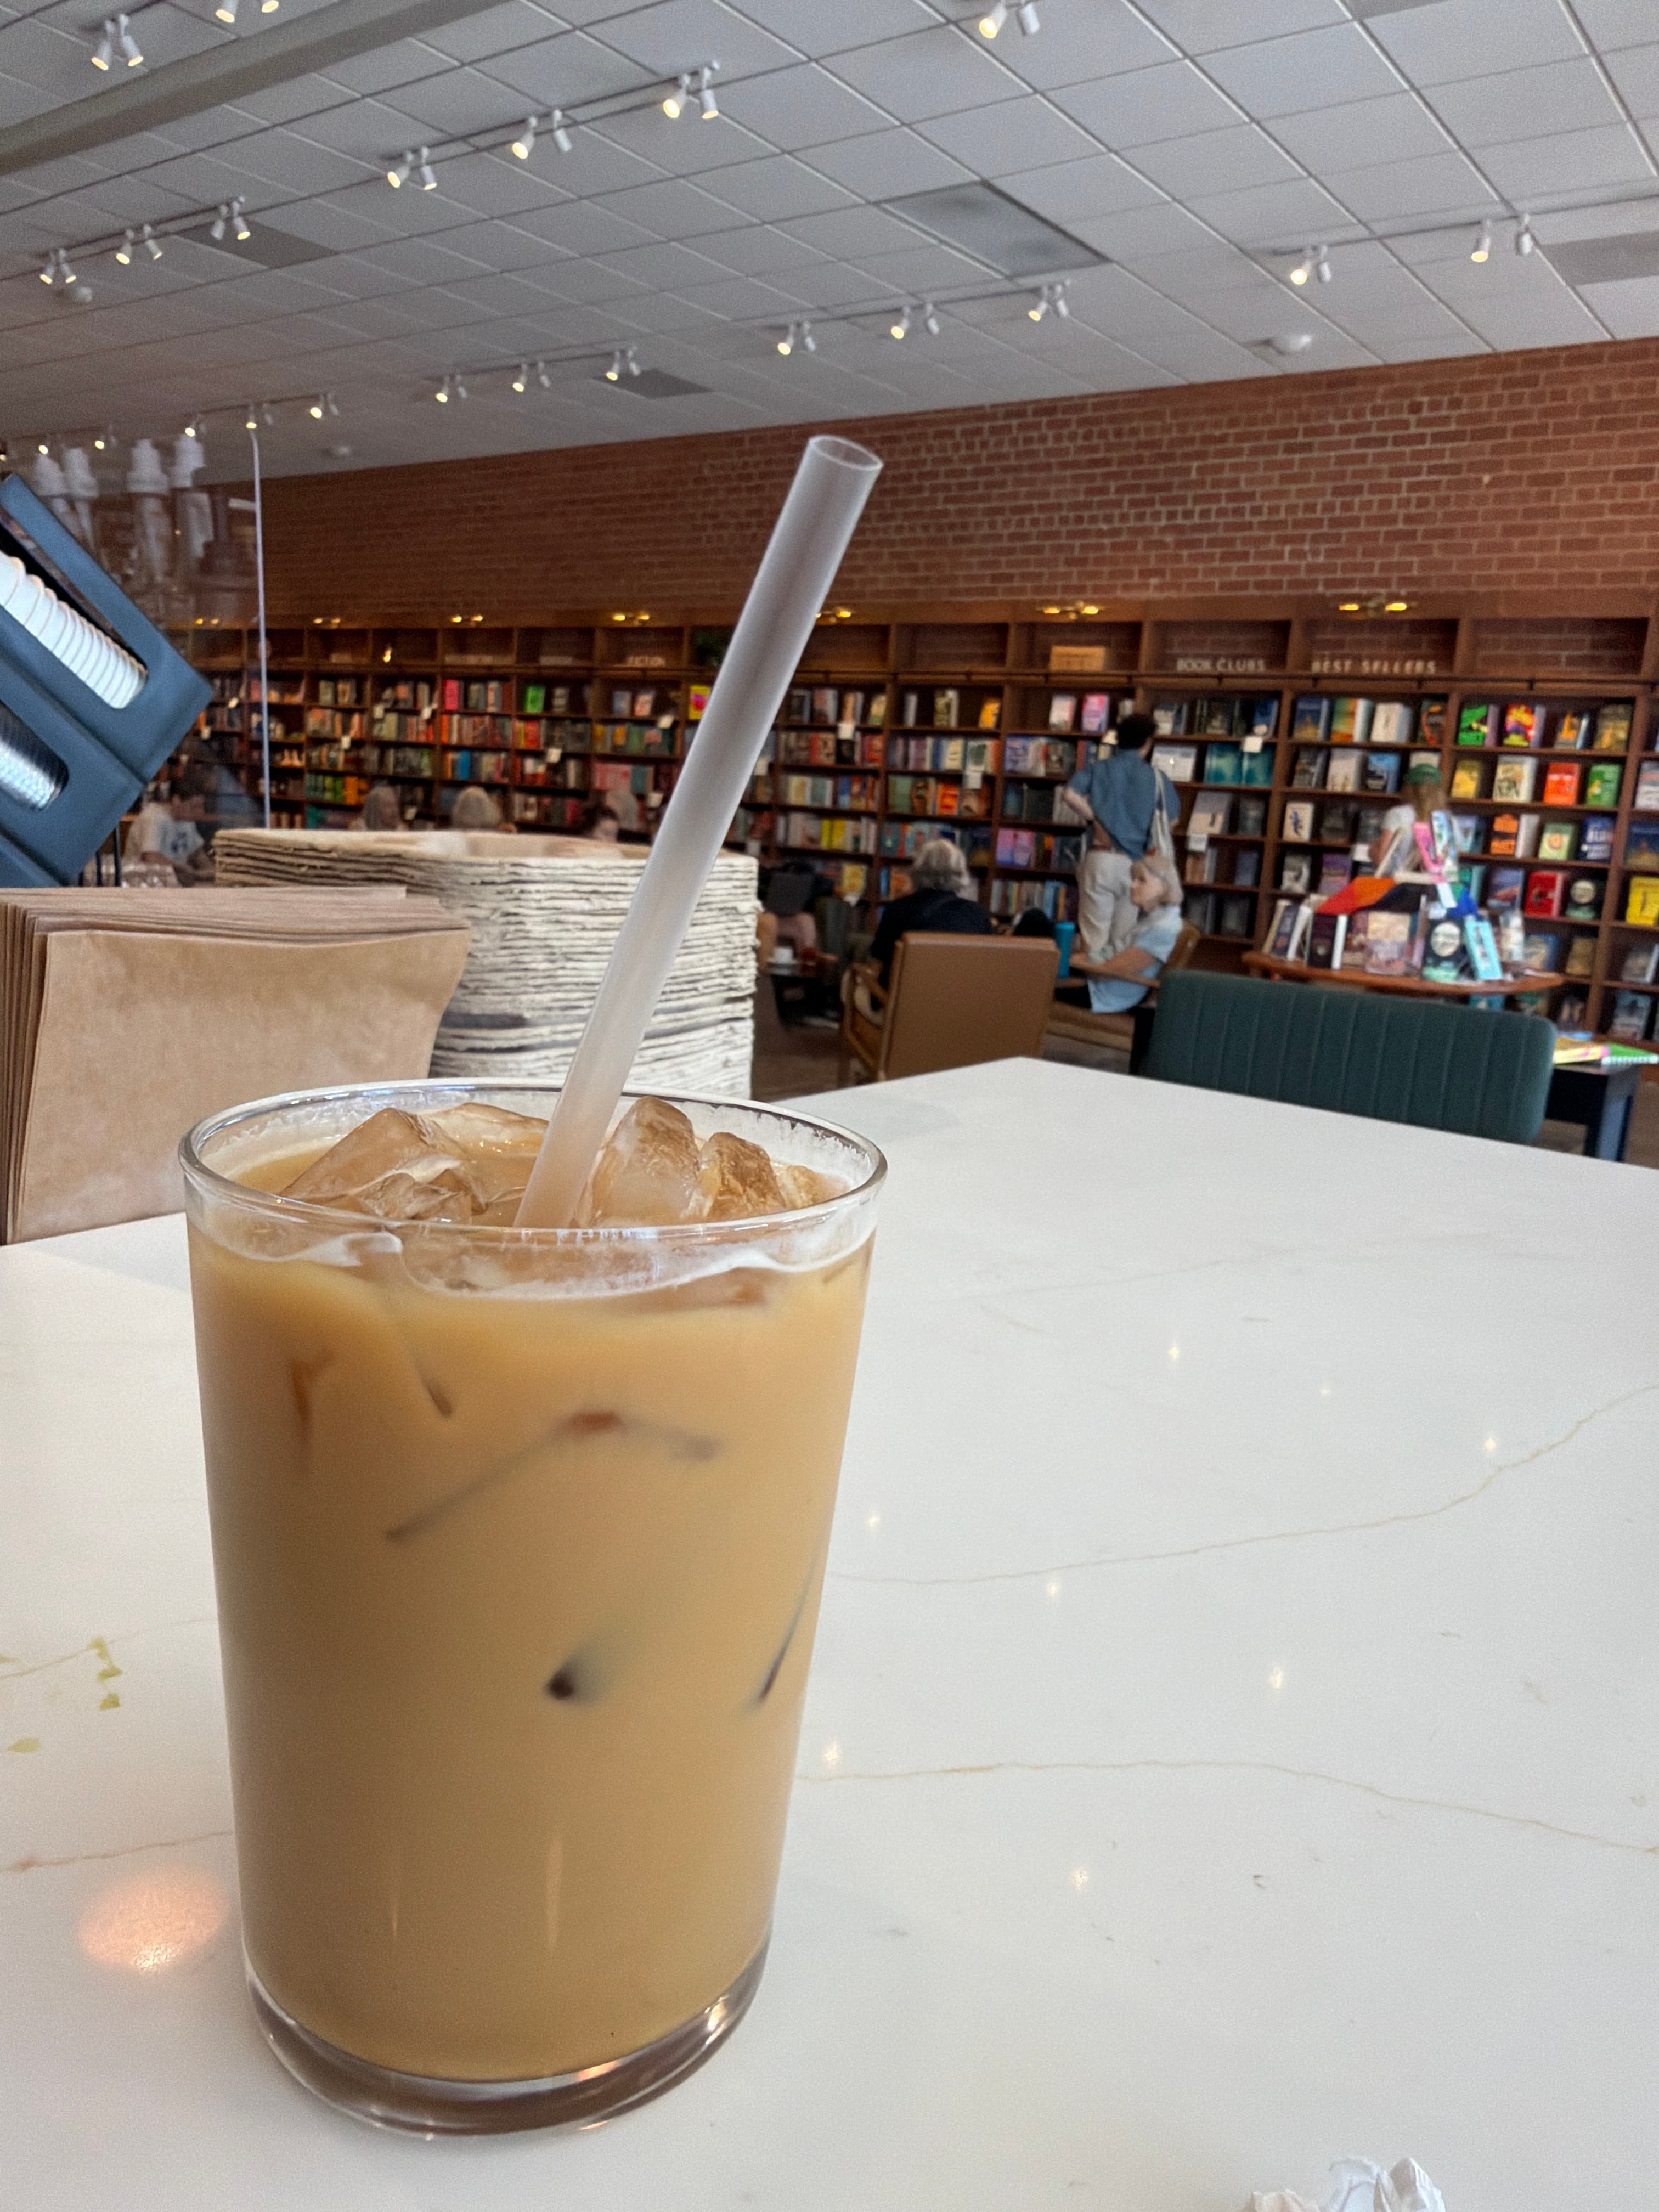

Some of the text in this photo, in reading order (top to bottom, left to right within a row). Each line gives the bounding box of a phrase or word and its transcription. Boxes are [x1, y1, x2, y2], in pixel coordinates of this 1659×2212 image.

[1176, 658, 1266, 672] BOOK CLUBS
[1311, 659, 1437, 674] BEST SELLERS
